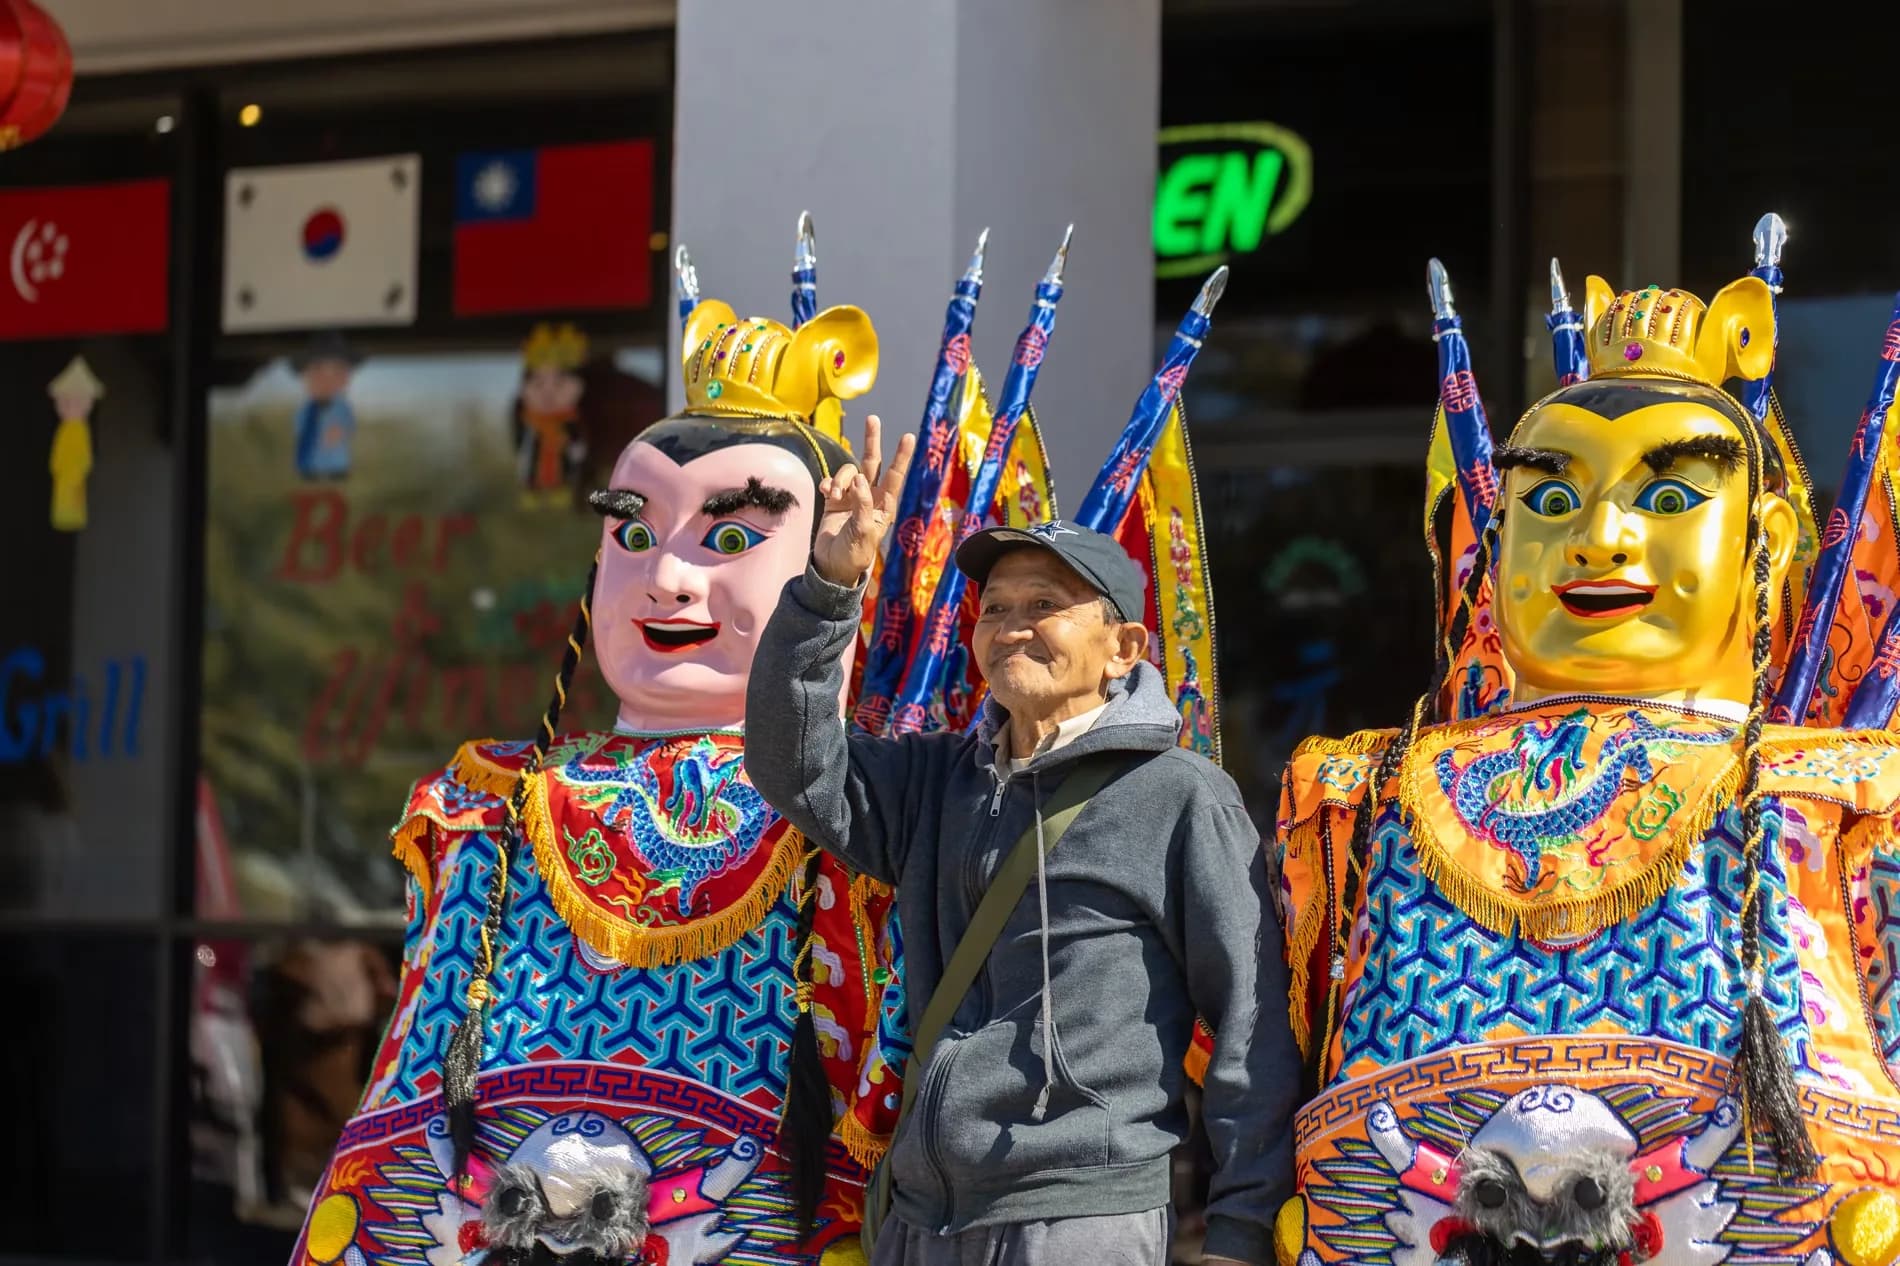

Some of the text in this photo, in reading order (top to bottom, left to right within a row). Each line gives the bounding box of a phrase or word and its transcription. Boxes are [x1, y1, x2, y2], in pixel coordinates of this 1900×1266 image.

[1153, 149, 1283, 255] EN
[277, 491, 476, 583] Beer
[0, 646, 146, 759] Grill
